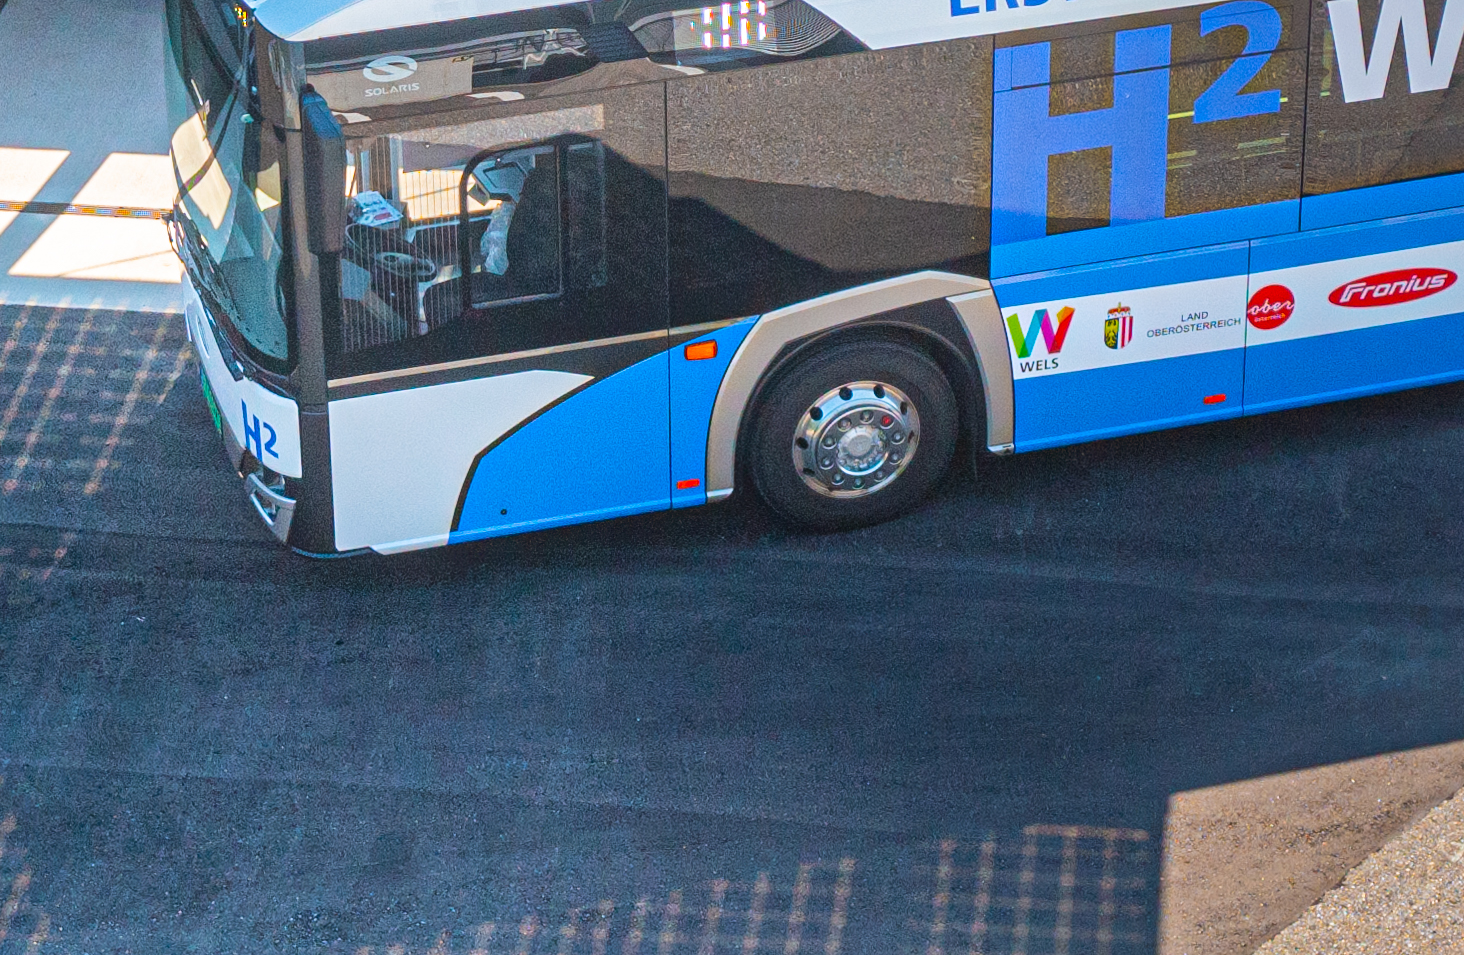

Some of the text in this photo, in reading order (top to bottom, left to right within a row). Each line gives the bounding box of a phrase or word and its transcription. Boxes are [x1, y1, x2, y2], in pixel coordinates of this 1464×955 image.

[364, 82, 420, 97] SOLARIS
[1339, 273, 1449, 304] Fronius
[1247, 298, 1295, 316] ober
[1180, 311, 1209, 323] LAND
[1254, 312, 1286, 323] österreich
[1146, 317, 1242, 338] OBERÖSTERREICH
[1019, 357, 1060, 373] WELS
